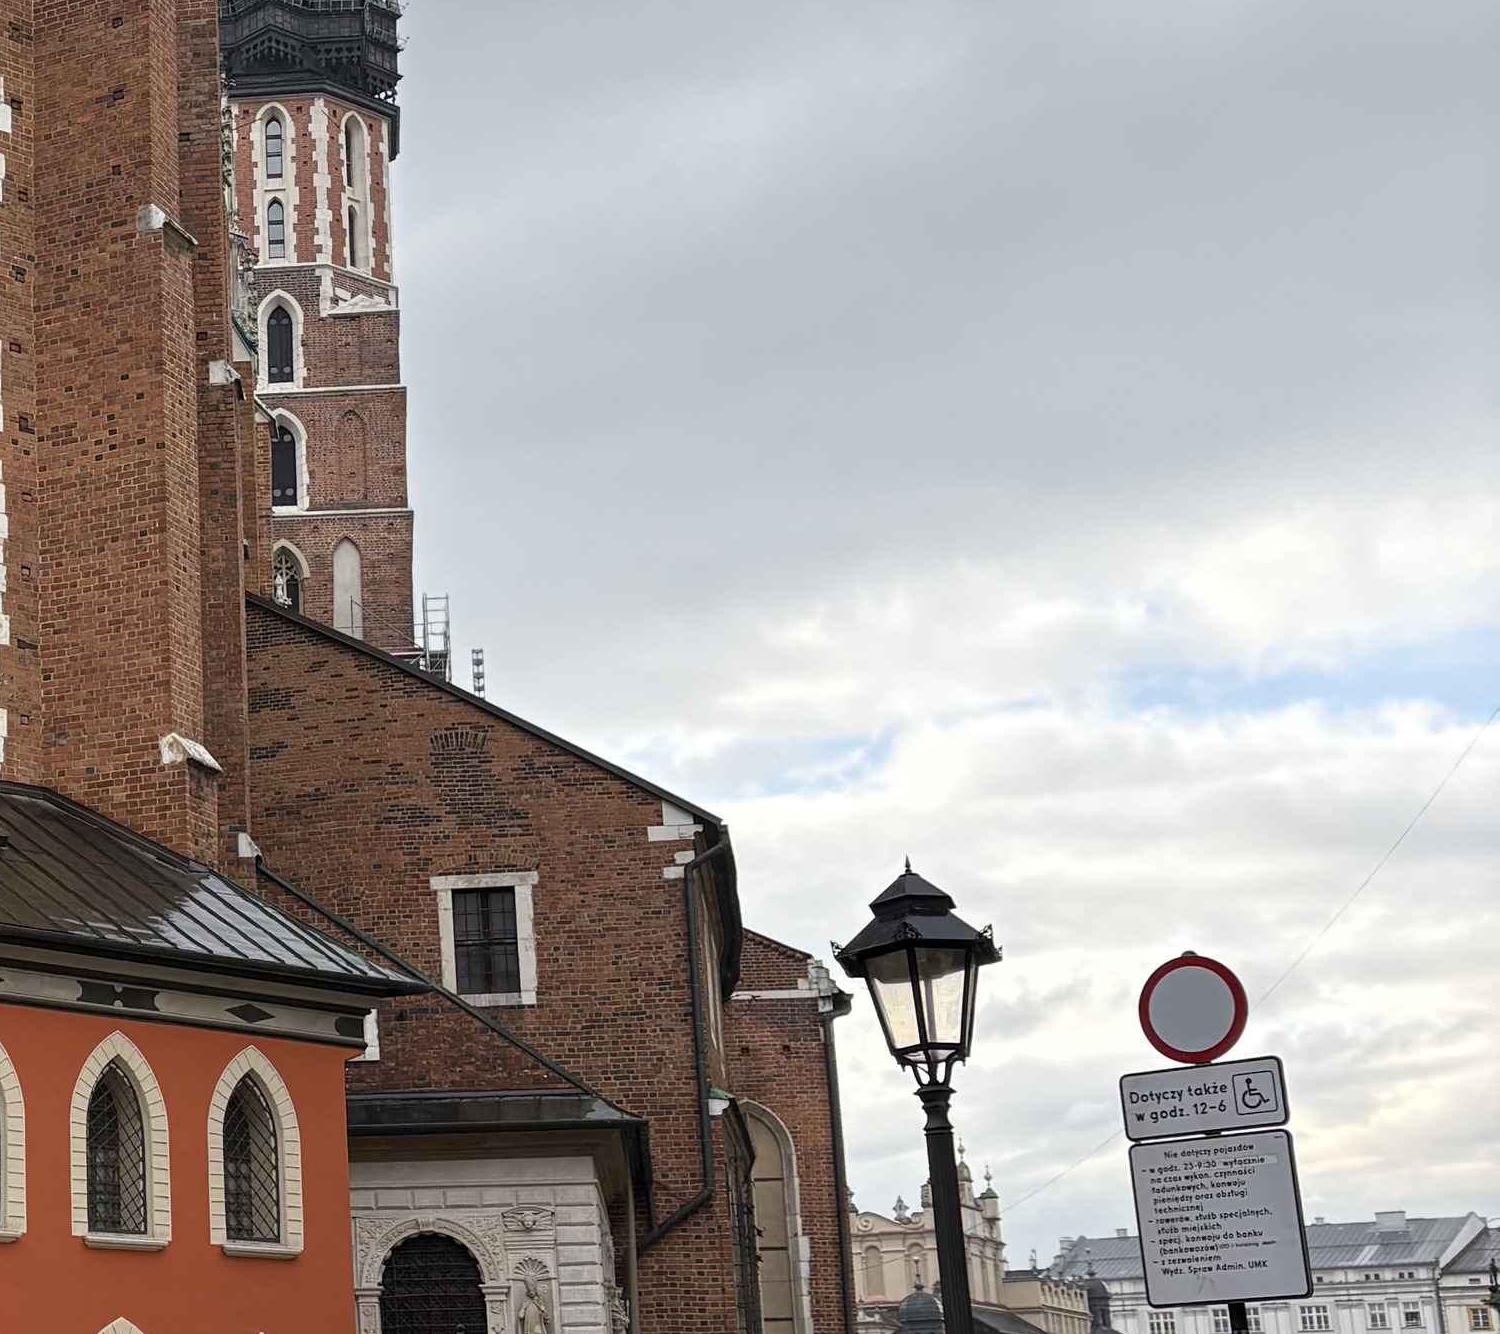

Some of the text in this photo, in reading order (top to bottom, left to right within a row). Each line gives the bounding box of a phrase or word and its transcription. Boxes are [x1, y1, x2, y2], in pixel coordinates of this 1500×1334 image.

[1129, 1081, 1228, 1105] Dotyczy także
[1135, 1099, 1227, 1123] w godz. 12-6
[1164, 1143, 1254, 1159] Nie dotyczy pojazdów
[1157, 1164, 1181, 1175] godz.
[1163, 1175, 1182, 1183] czas
[1210, 1178, 1246, 1189] konwoju
[1195, 1193, 1214, 1201] oraz
[1154, 1202, 1204, 1214] technicznej
[1181, 1222, 1222, 1233] miejskich
[1185, 1233, 1221, 1243] konwoju
[1223, 1231, 1234, 1239] do
[1236, 1229, 1264, 1238] banku
[1188, 1265, 1213, 1275] Spraw
[1215, 1262, 1247, 1272] Admin.
[1249, 1259, 1269, 1269] UMK
